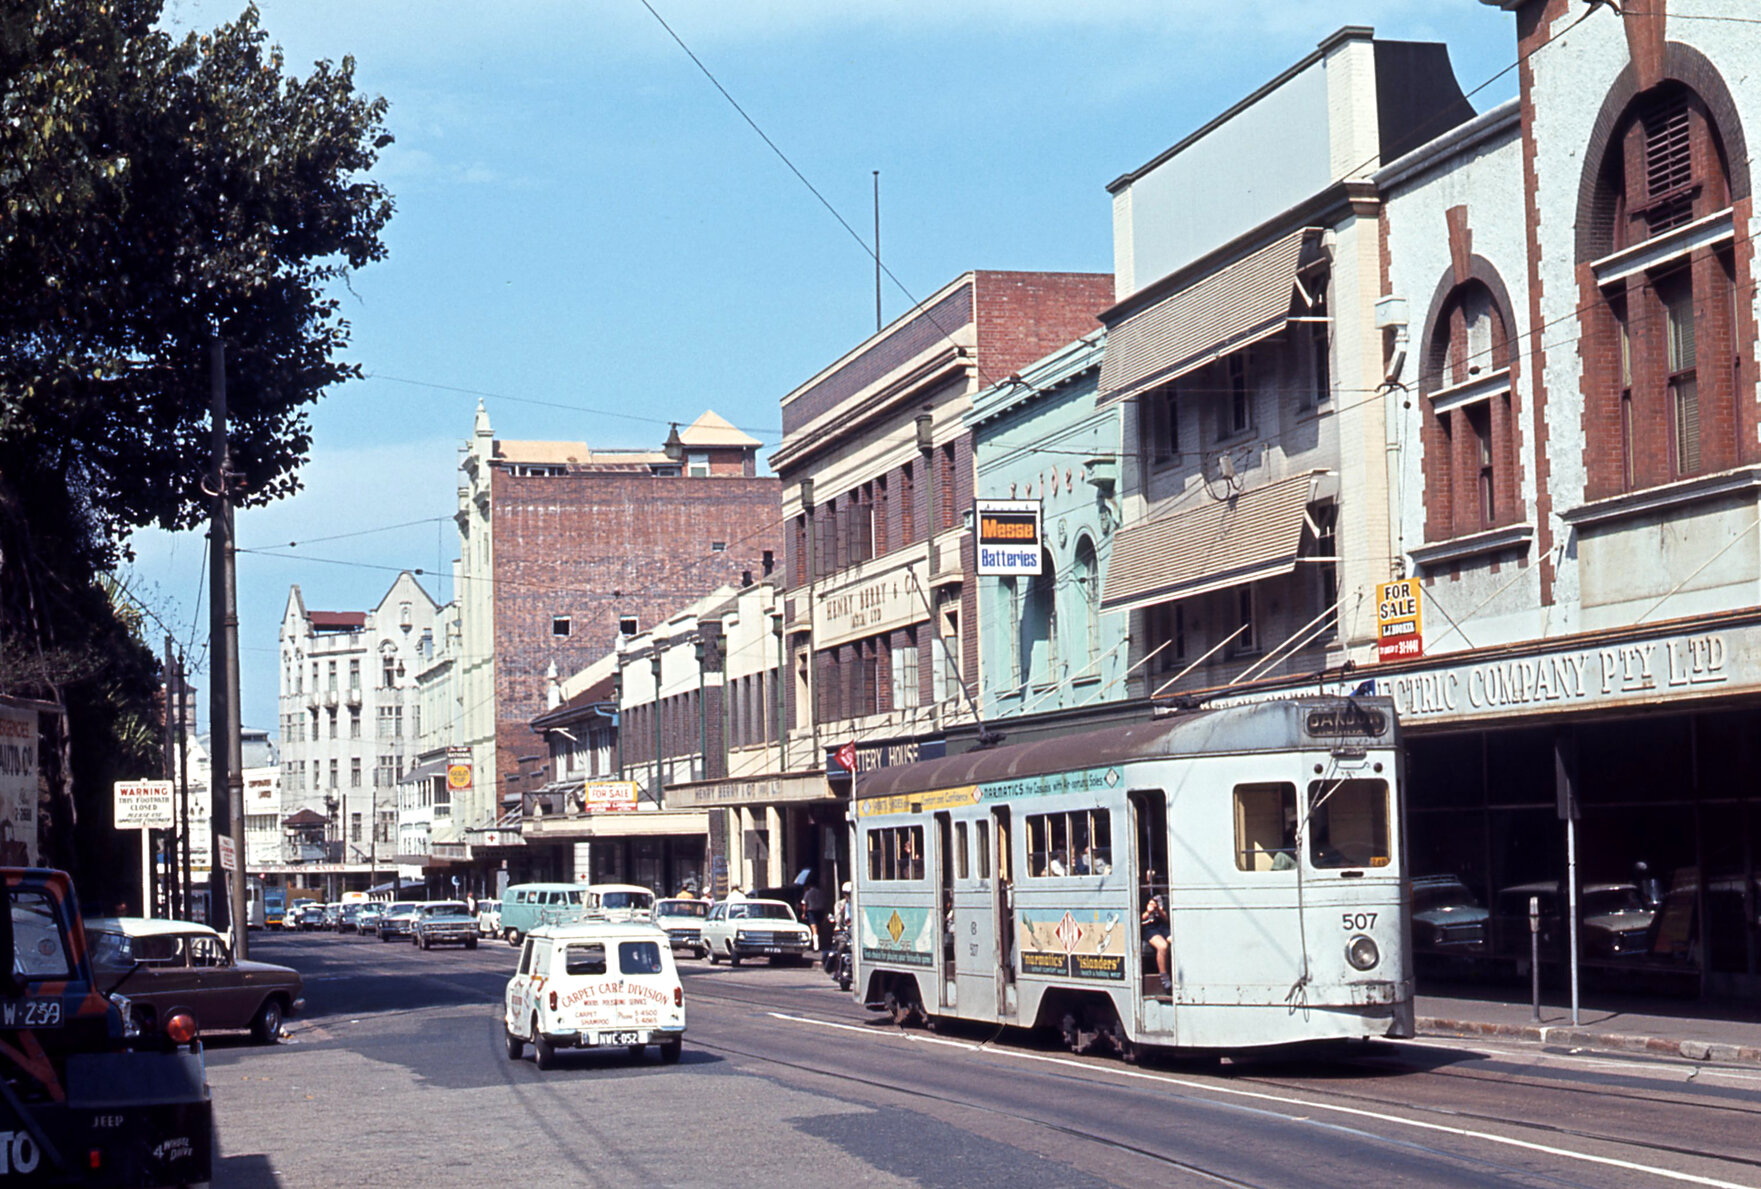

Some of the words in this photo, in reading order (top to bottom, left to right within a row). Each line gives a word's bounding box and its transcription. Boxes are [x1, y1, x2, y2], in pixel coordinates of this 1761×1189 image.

[982, 519, 1034, 538] Masse
[982, 549, 1037, 567] Batteries
[1385, 584, 1410, 600] FOR
[827, 595, 853, 620] HENRY
[860, 583, 886, 609] BERRY
[1380, 599, 1416, 619] SALE
[1467, 653, 1588, 708] COMPANY
[1600, 643, 1658, 693] PTY
[1667, 635, 1728, 686] LTD
[855, 748, 883, 772] TTERY
[888, 743, 919, 767] HOUSE
[120, 788, 168, 796] WARNING
[592, 789, 607, 798] FOR
[609, 789, 629, 798] SALE
[1342, 912, 1378, 930] 507
[561, 986, 595, 1008] CARPET
[598, 982, 624, 994] CARE
[628, 983, 670, 1005] DIVISION
[575, 1010, 597, 1018] CARPET
[92, 1114, 124, 1128] JEEP
[153, 1144, 164, 1158] 4
